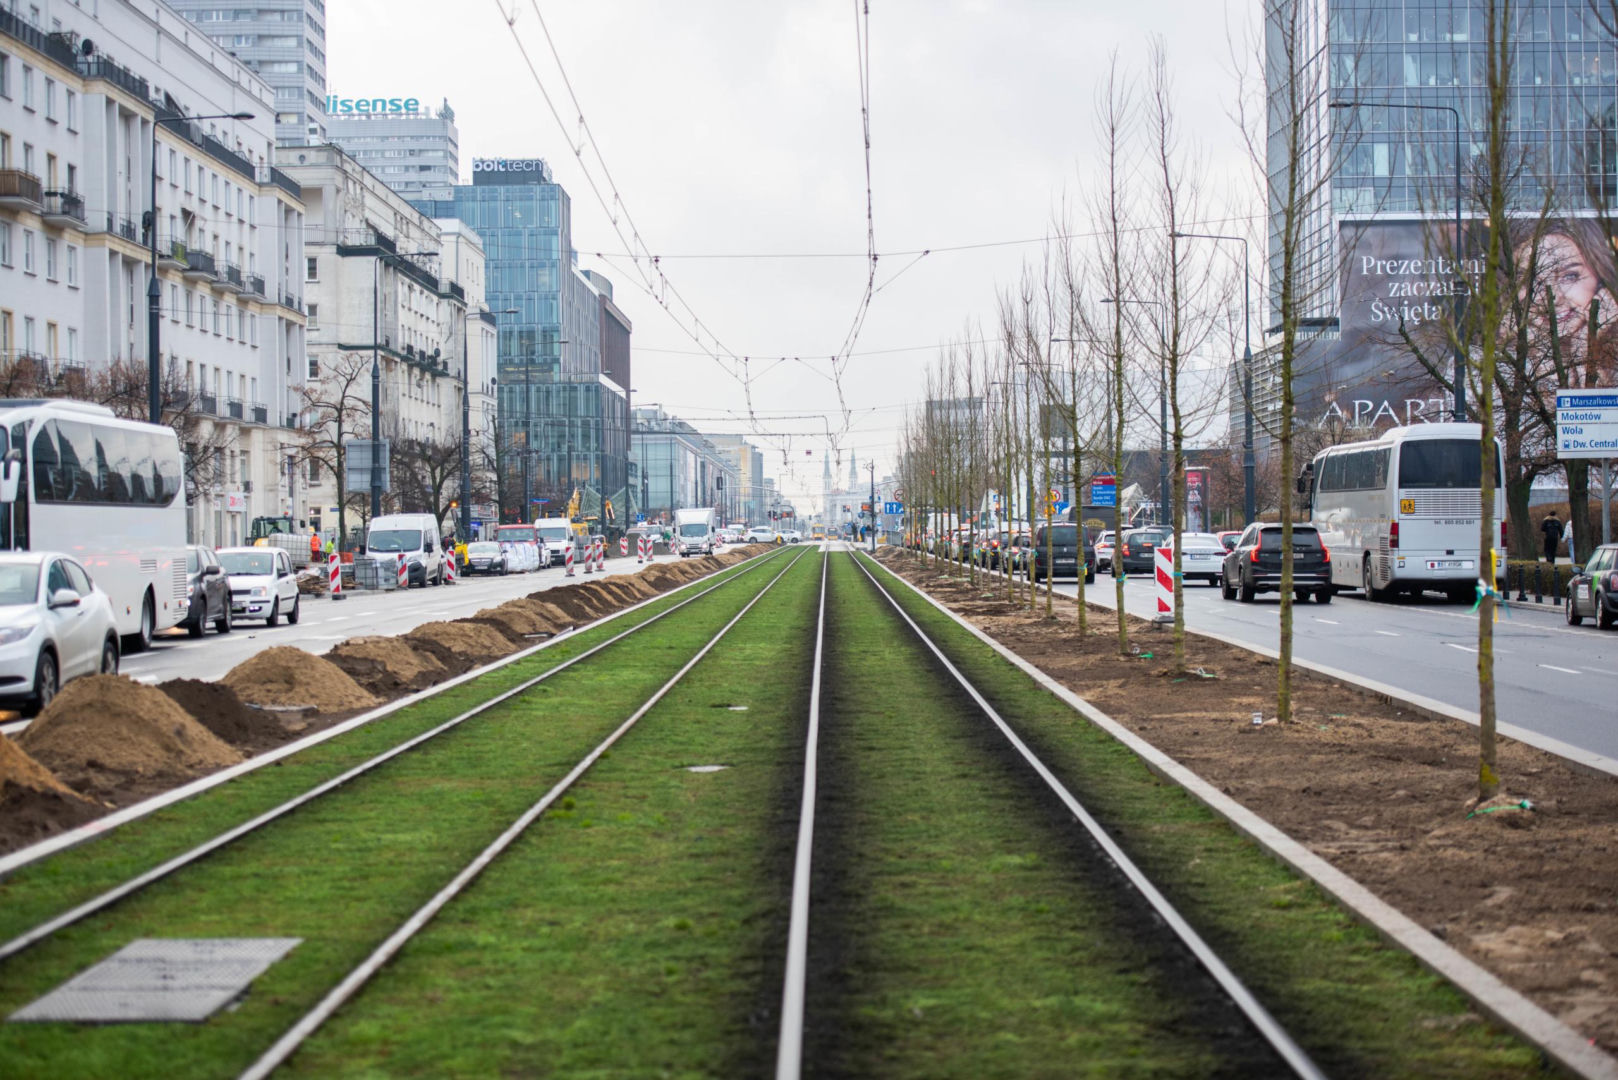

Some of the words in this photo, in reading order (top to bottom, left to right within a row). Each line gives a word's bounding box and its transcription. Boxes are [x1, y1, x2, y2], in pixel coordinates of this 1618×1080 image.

[1371, 298, 1443, 325] Święta
[1318, 398, 1446, 429] APART
[1561, 411, 1602, 421] Mokotów
[1561, 425, 1583, 435] Wola
[1573, 440, 1588, 449] Dw.
